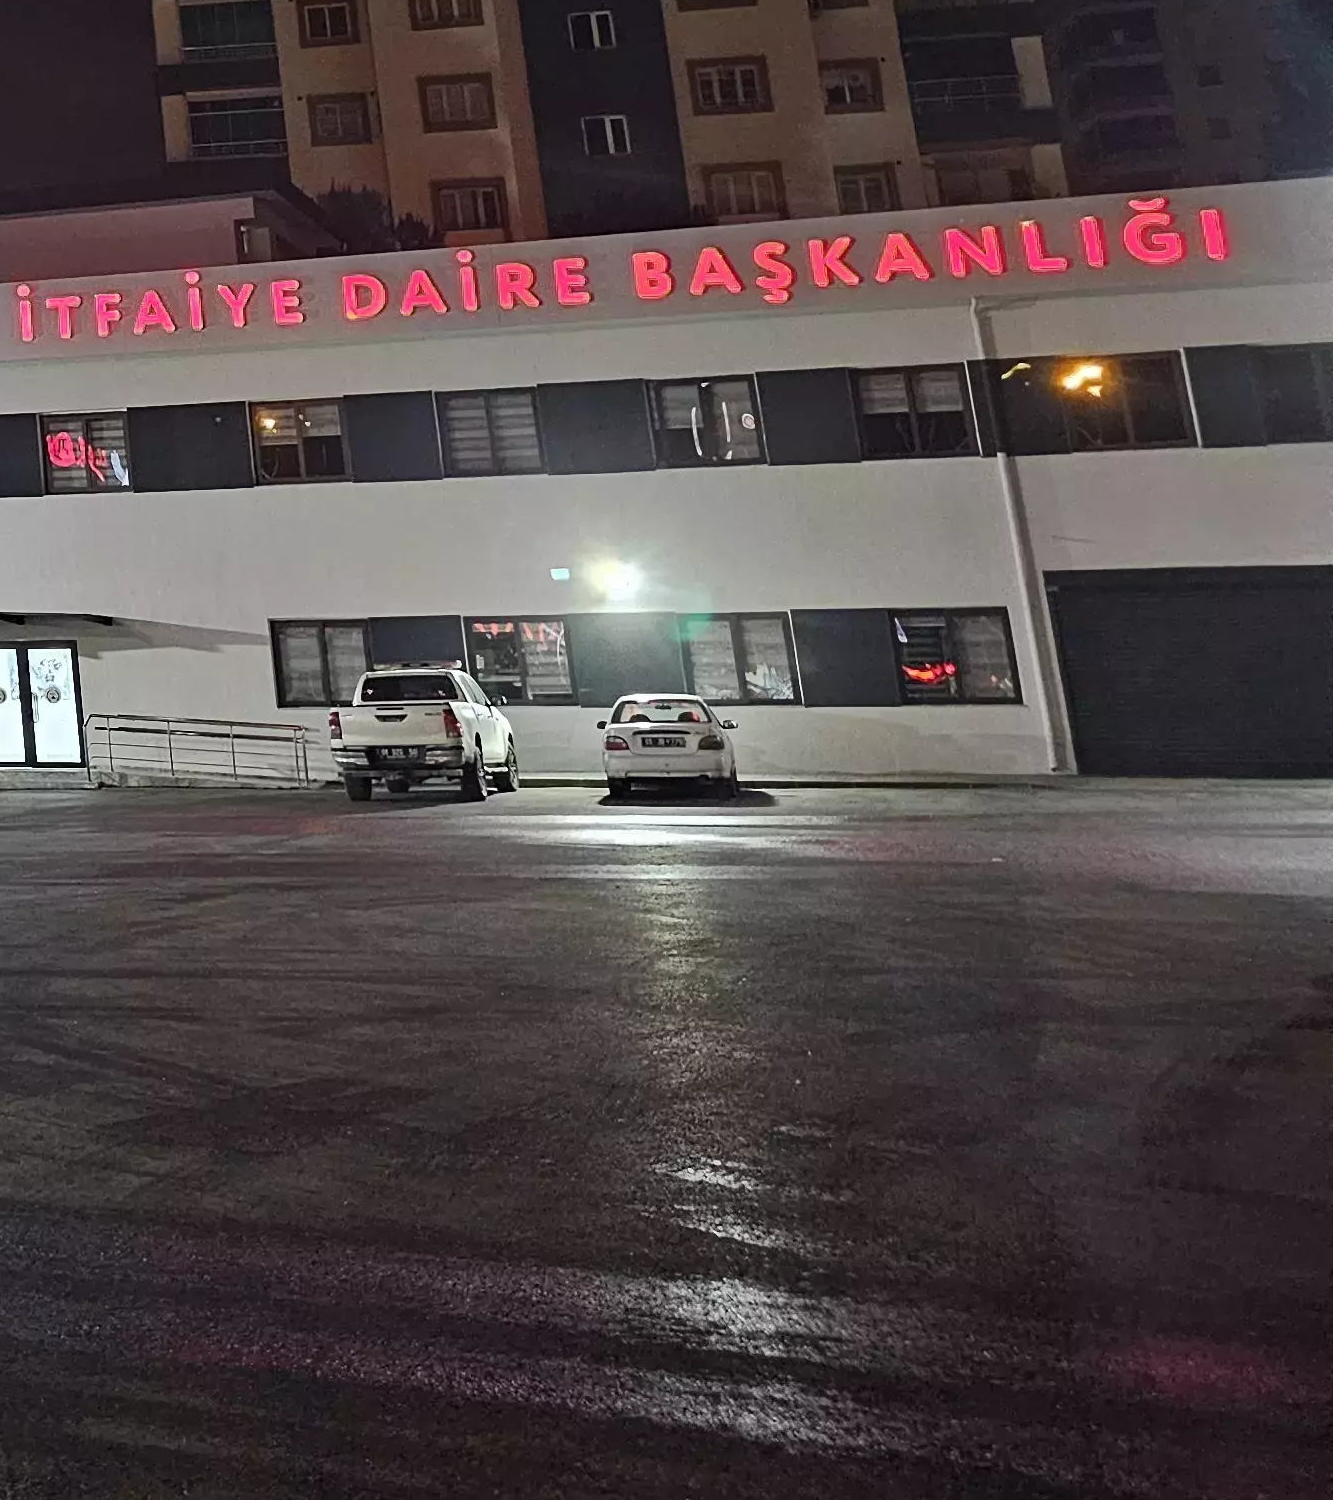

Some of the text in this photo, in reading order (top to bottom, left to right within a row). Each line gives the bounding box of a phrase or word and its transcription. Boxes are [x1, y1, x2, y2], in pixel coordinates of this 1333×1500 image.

[16, 197, 1227, 342] İTFAİYE DAİRE BAŞKANLIĞI
